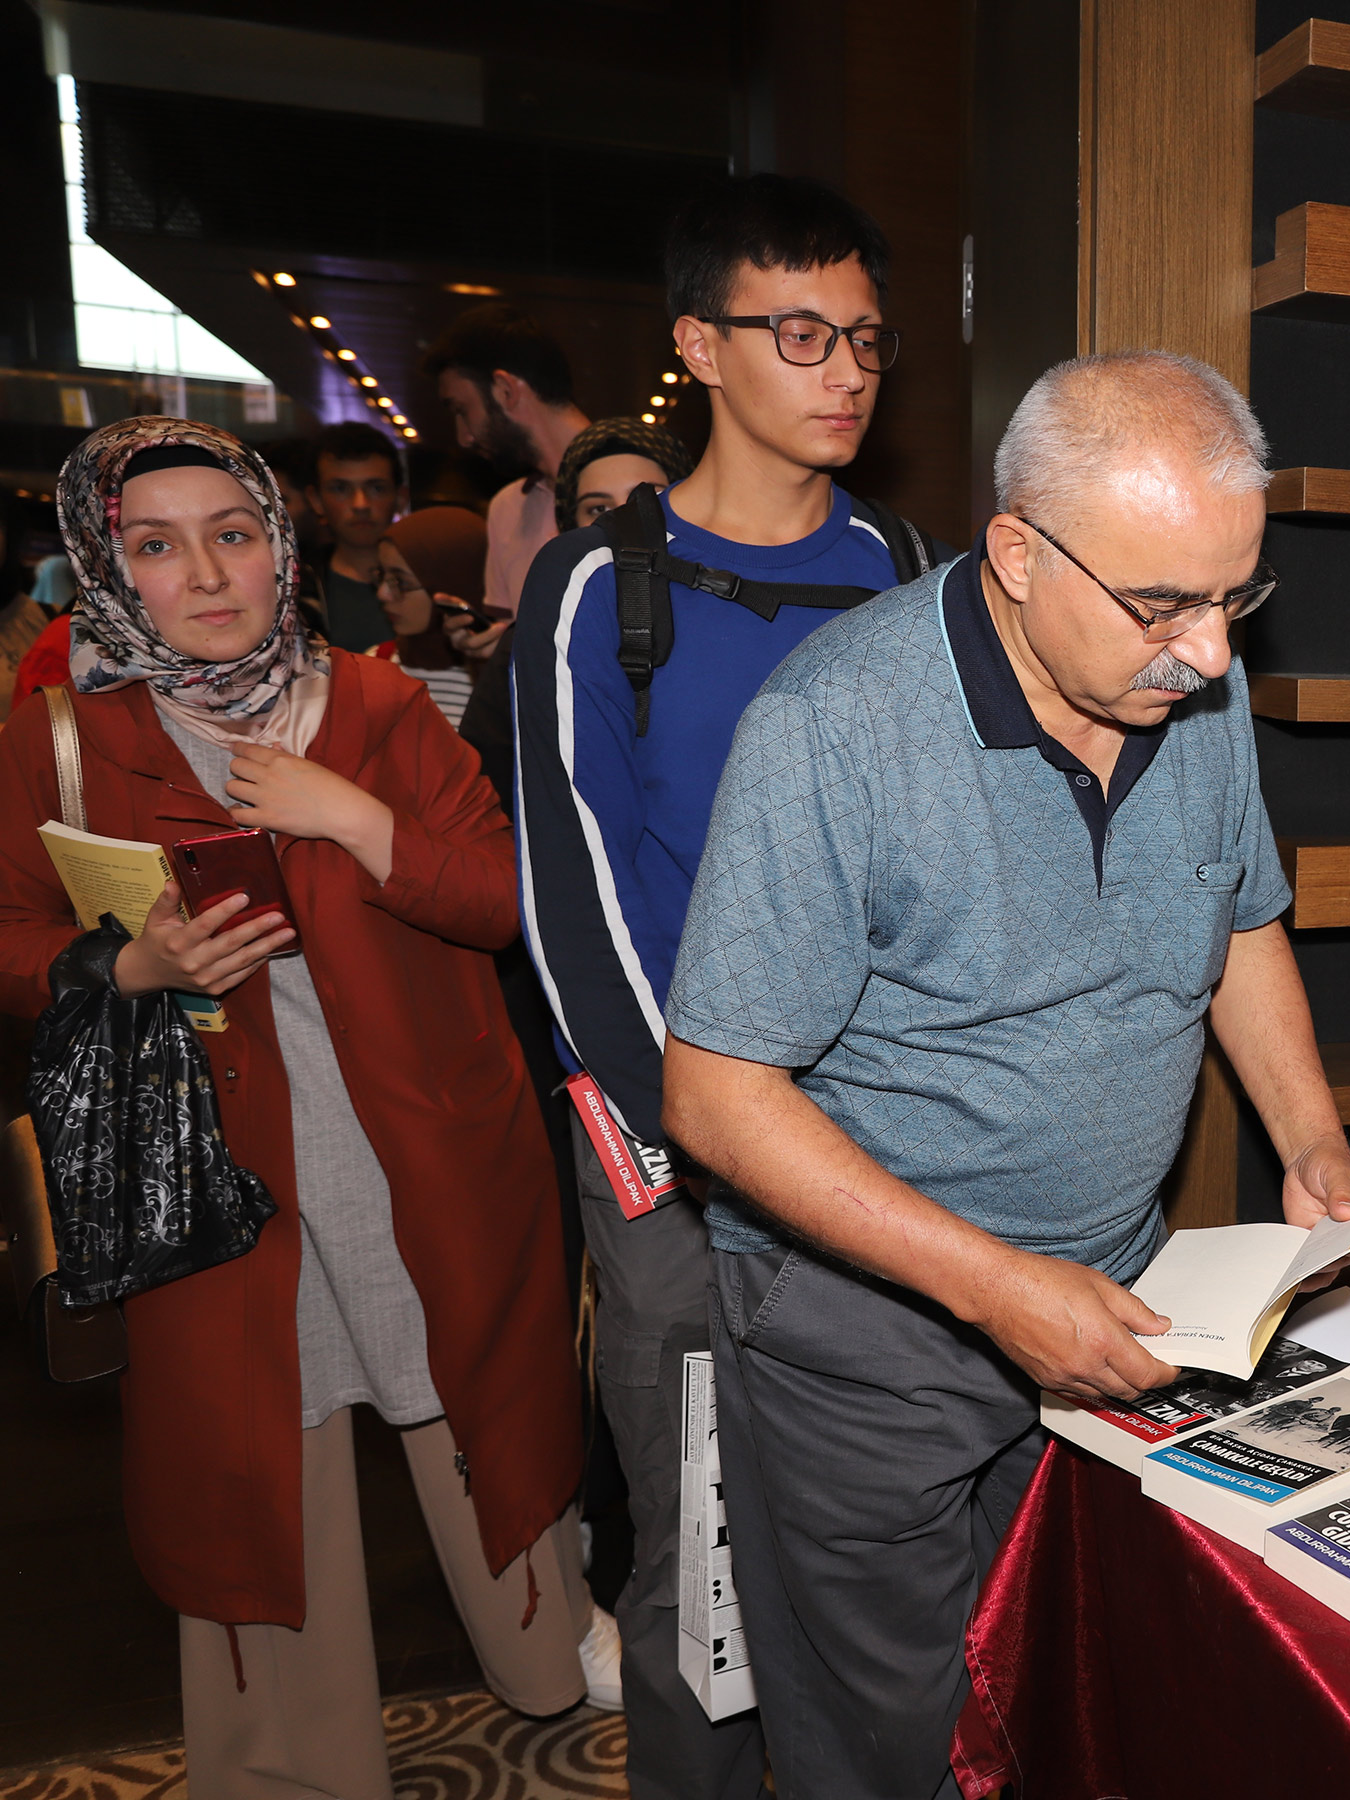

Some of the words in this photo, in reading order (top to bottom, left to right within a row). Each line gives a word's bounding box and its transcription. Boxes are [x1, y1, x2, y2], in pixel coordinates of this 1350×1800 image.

[583, 1090, 626, 1167] ABDURRAHMAN
[1162, 1452, 1238, 1483] ABDURRAHMAN
[1189, 1439, 1262, 1469] ÇANAKKALE
[1258, 1460, 1313, 1483] GEÇİLDİ
